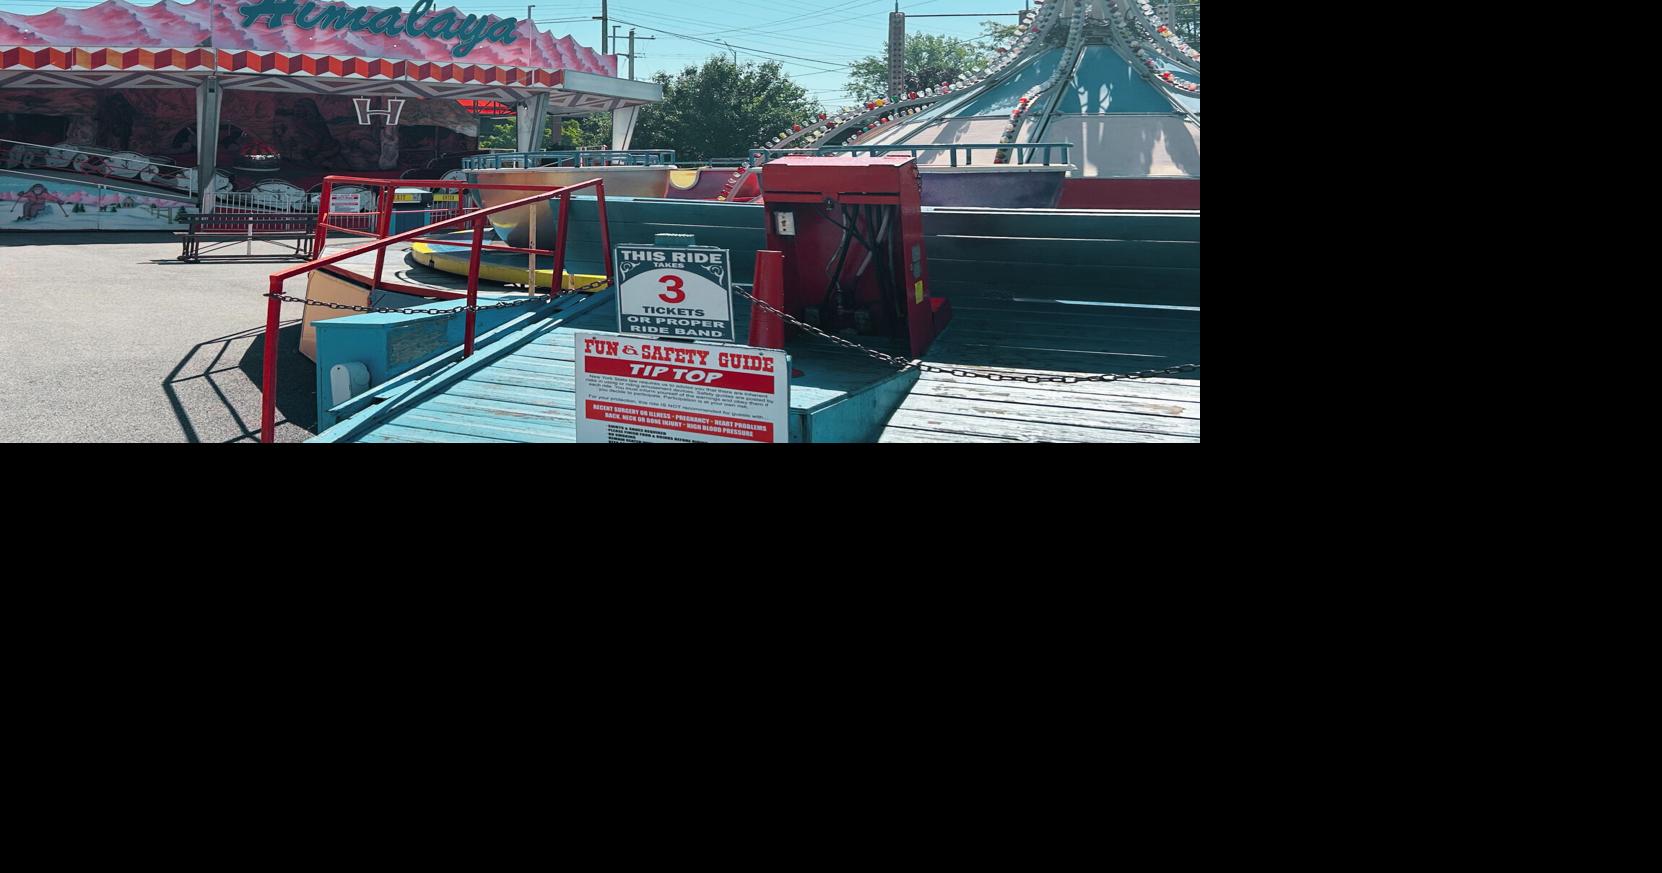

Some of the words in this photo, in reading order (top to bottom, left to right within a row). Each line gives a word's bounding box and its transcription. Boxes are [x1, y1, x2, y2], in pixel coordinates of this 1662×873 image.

[239, 0, 517, 57] Himalaya
[621, 250, 666, 262] THIS
[671, 252, 723, 264] RIDE
[653, 261, 685, 269] TAKES
[658, 274, 686, 304] 3
[642, 305, 705, 317] TICKETS
[627, 315, 651, 324] OR
[656, 317, 725, 329] PROPER
[630, 325, 669, 334] RIDE
[674, 328, 723, 338] BAND
[585, 339, 619, 356] FUN
[622, 345, 639, 355] &
[641, 344, 710, 366] SAFETY
[718, 352, 774, 373] GUIDE
[630, 363, 669, 377] TIP
[672, 368, 723, 383] TOP
[675, 415, 709, 424] PREGNANCY
[734, 422, 766, 431] PROBLEMS
[722, 427, 754, 435] PRESSURE
